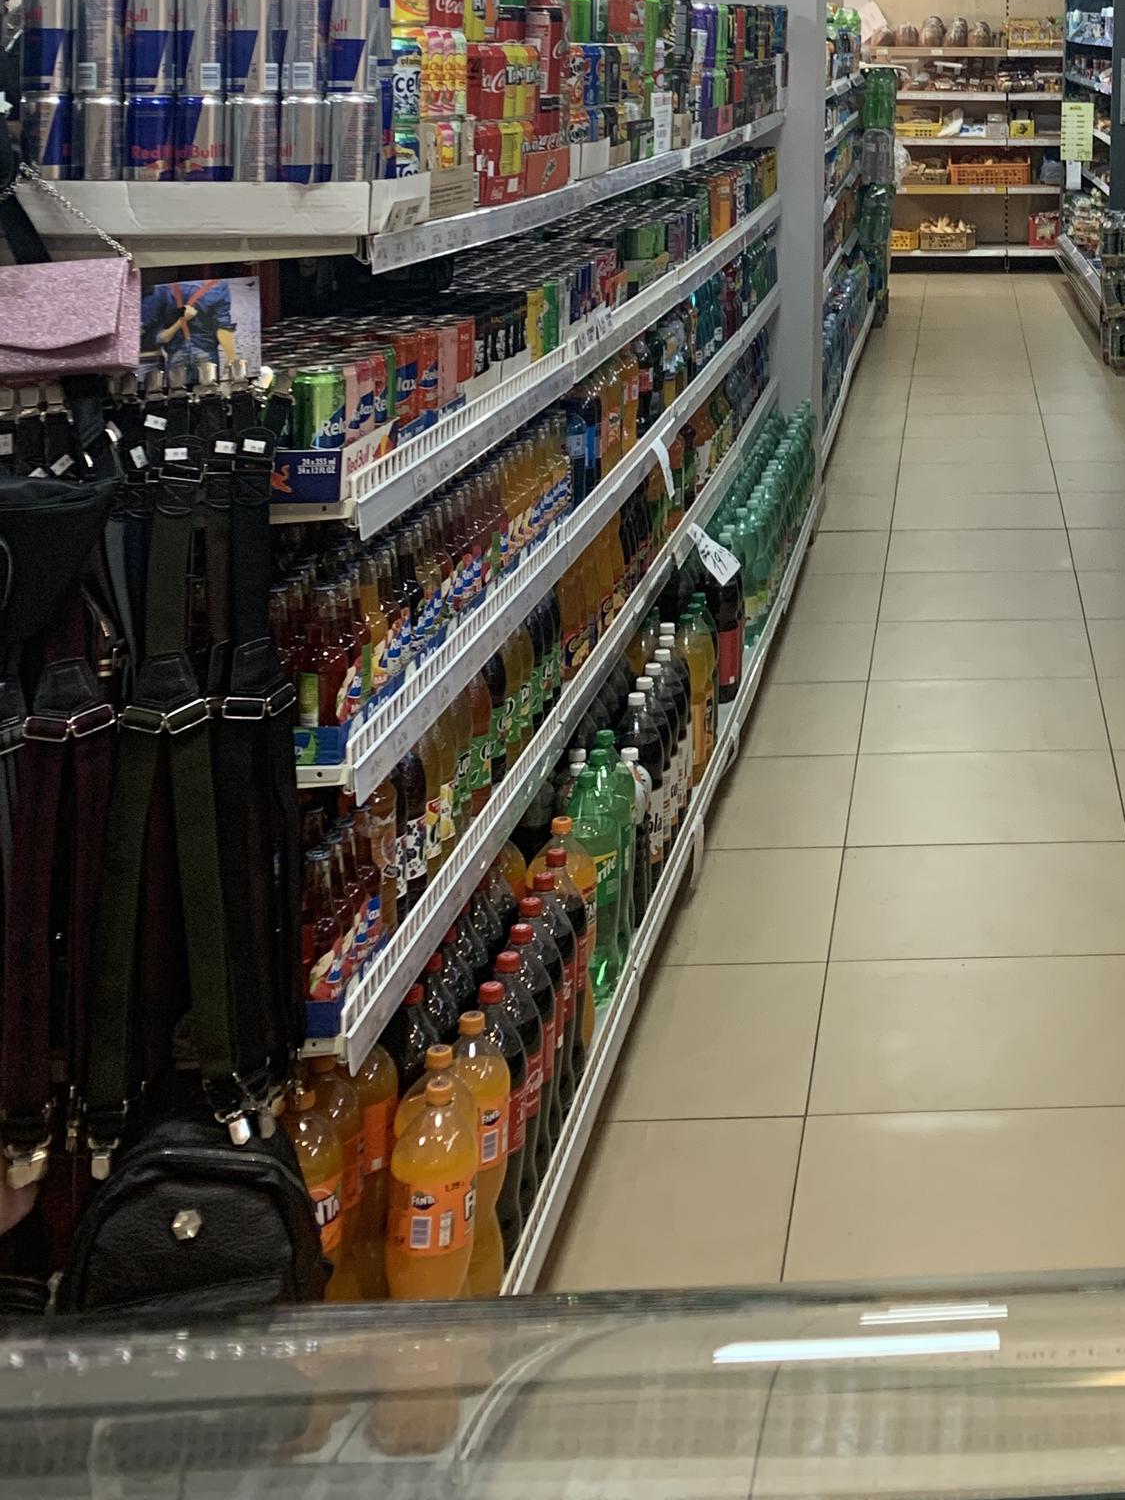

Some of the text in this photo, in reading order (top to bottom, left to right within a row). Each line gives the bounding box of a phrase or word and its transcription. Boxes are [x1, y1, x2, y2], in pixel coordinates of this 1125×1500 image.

[397, 376, 418, 392] lax
[319, 417, 345, 438] Rel
[598, 855, 618, 884] rite
